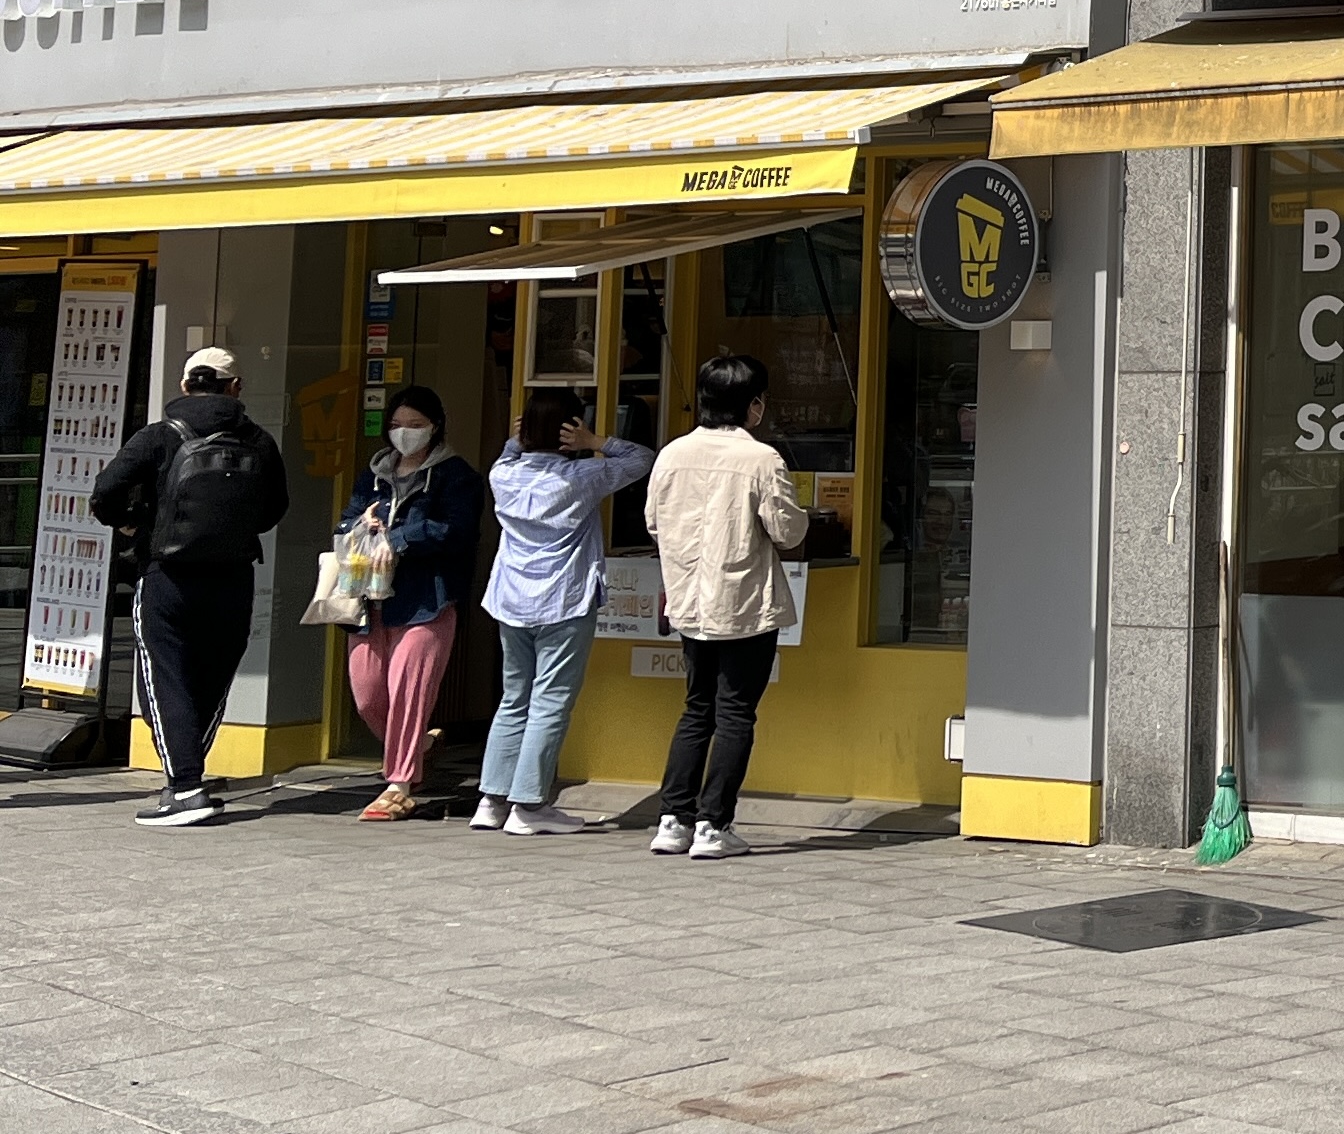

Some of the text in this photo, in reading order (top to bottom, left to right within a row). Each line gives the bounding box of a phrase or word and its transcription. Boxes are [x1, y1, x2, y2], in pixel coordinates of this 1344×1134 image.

[681, 167, 793, 192] MEGA COFFEE
[986, 176, 1011, 202] MEGA
[1012, 202, 1030, 246] COFFEE
